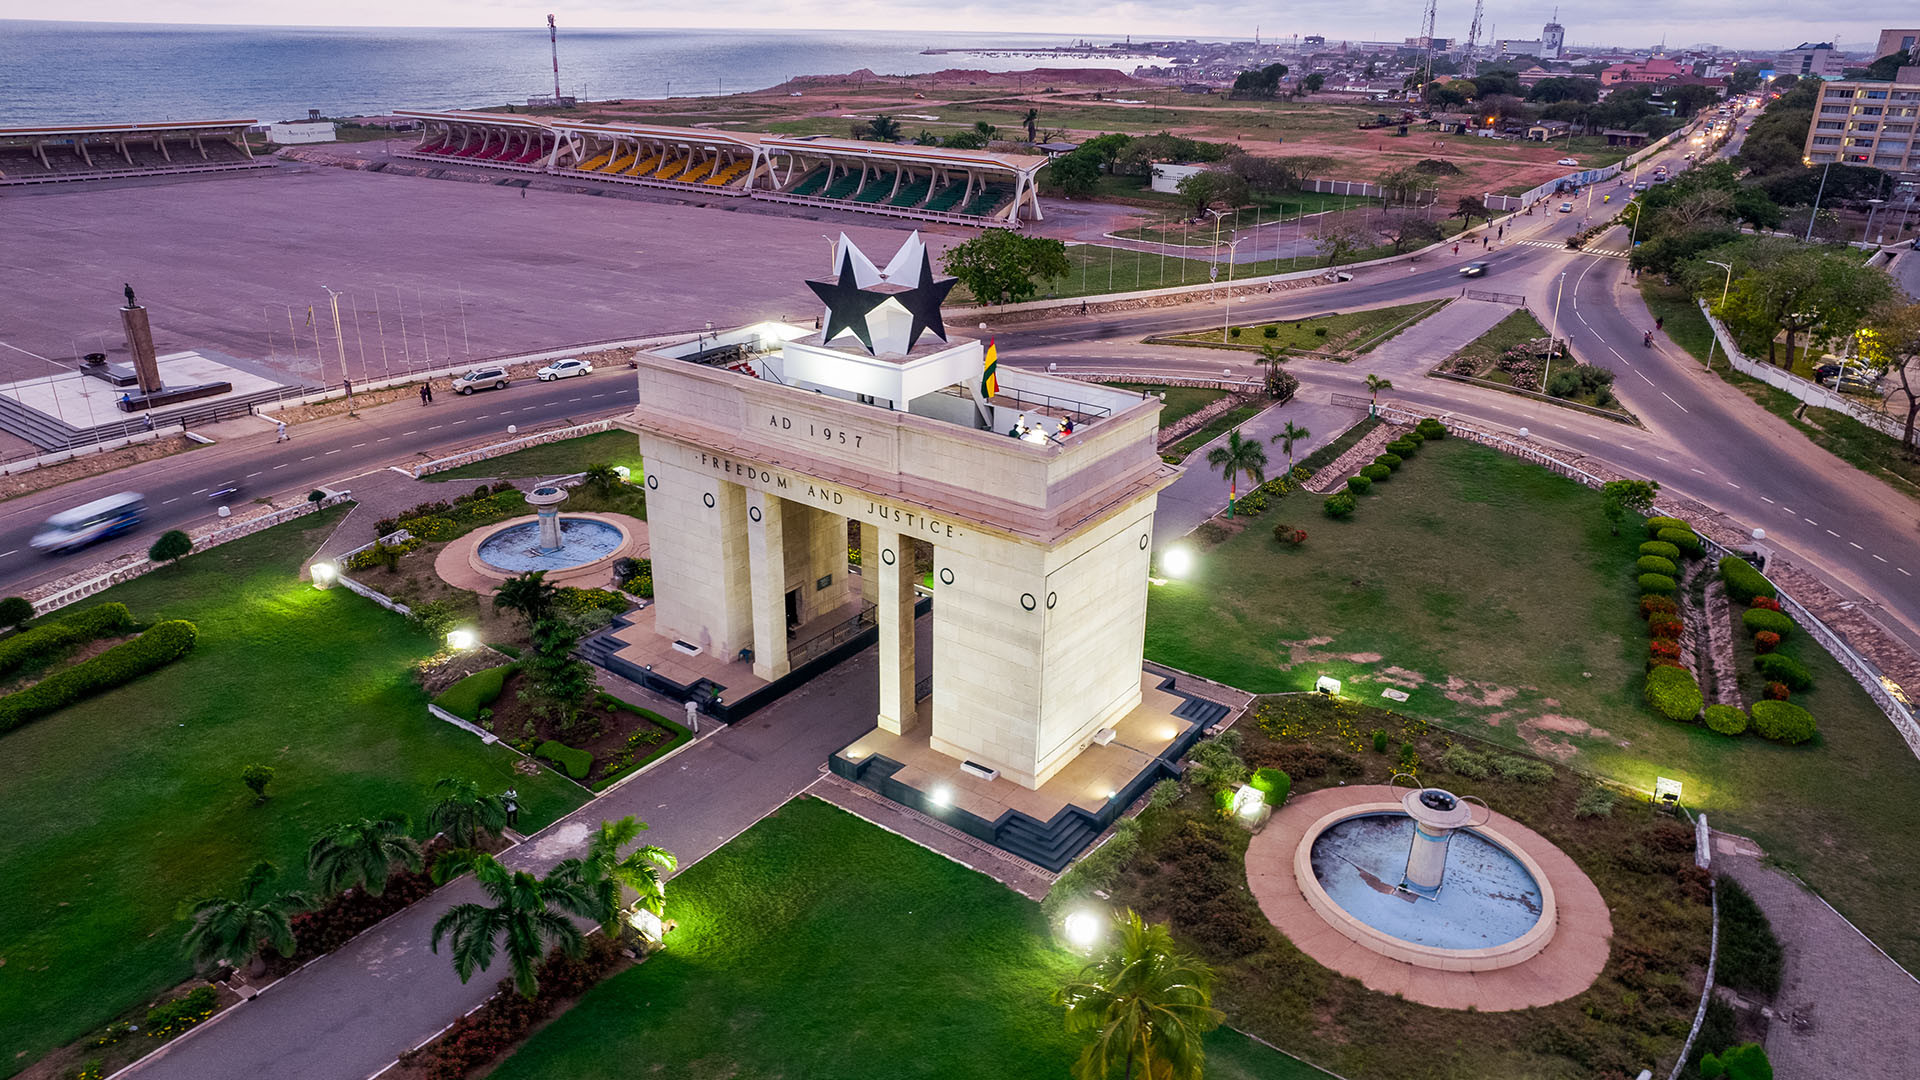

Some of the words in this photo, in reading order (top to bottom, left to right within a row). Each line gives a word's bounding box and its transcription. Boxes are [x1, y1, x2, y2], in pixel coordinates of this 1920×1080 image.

[770, 415, 792, 430] AD
[810, 424, 863, 448] 1957
[700, 453, 788, 489] FREEDOM
[808, 485, 843, 505] AND
[867, 502, 954, 538] JUSTICE
